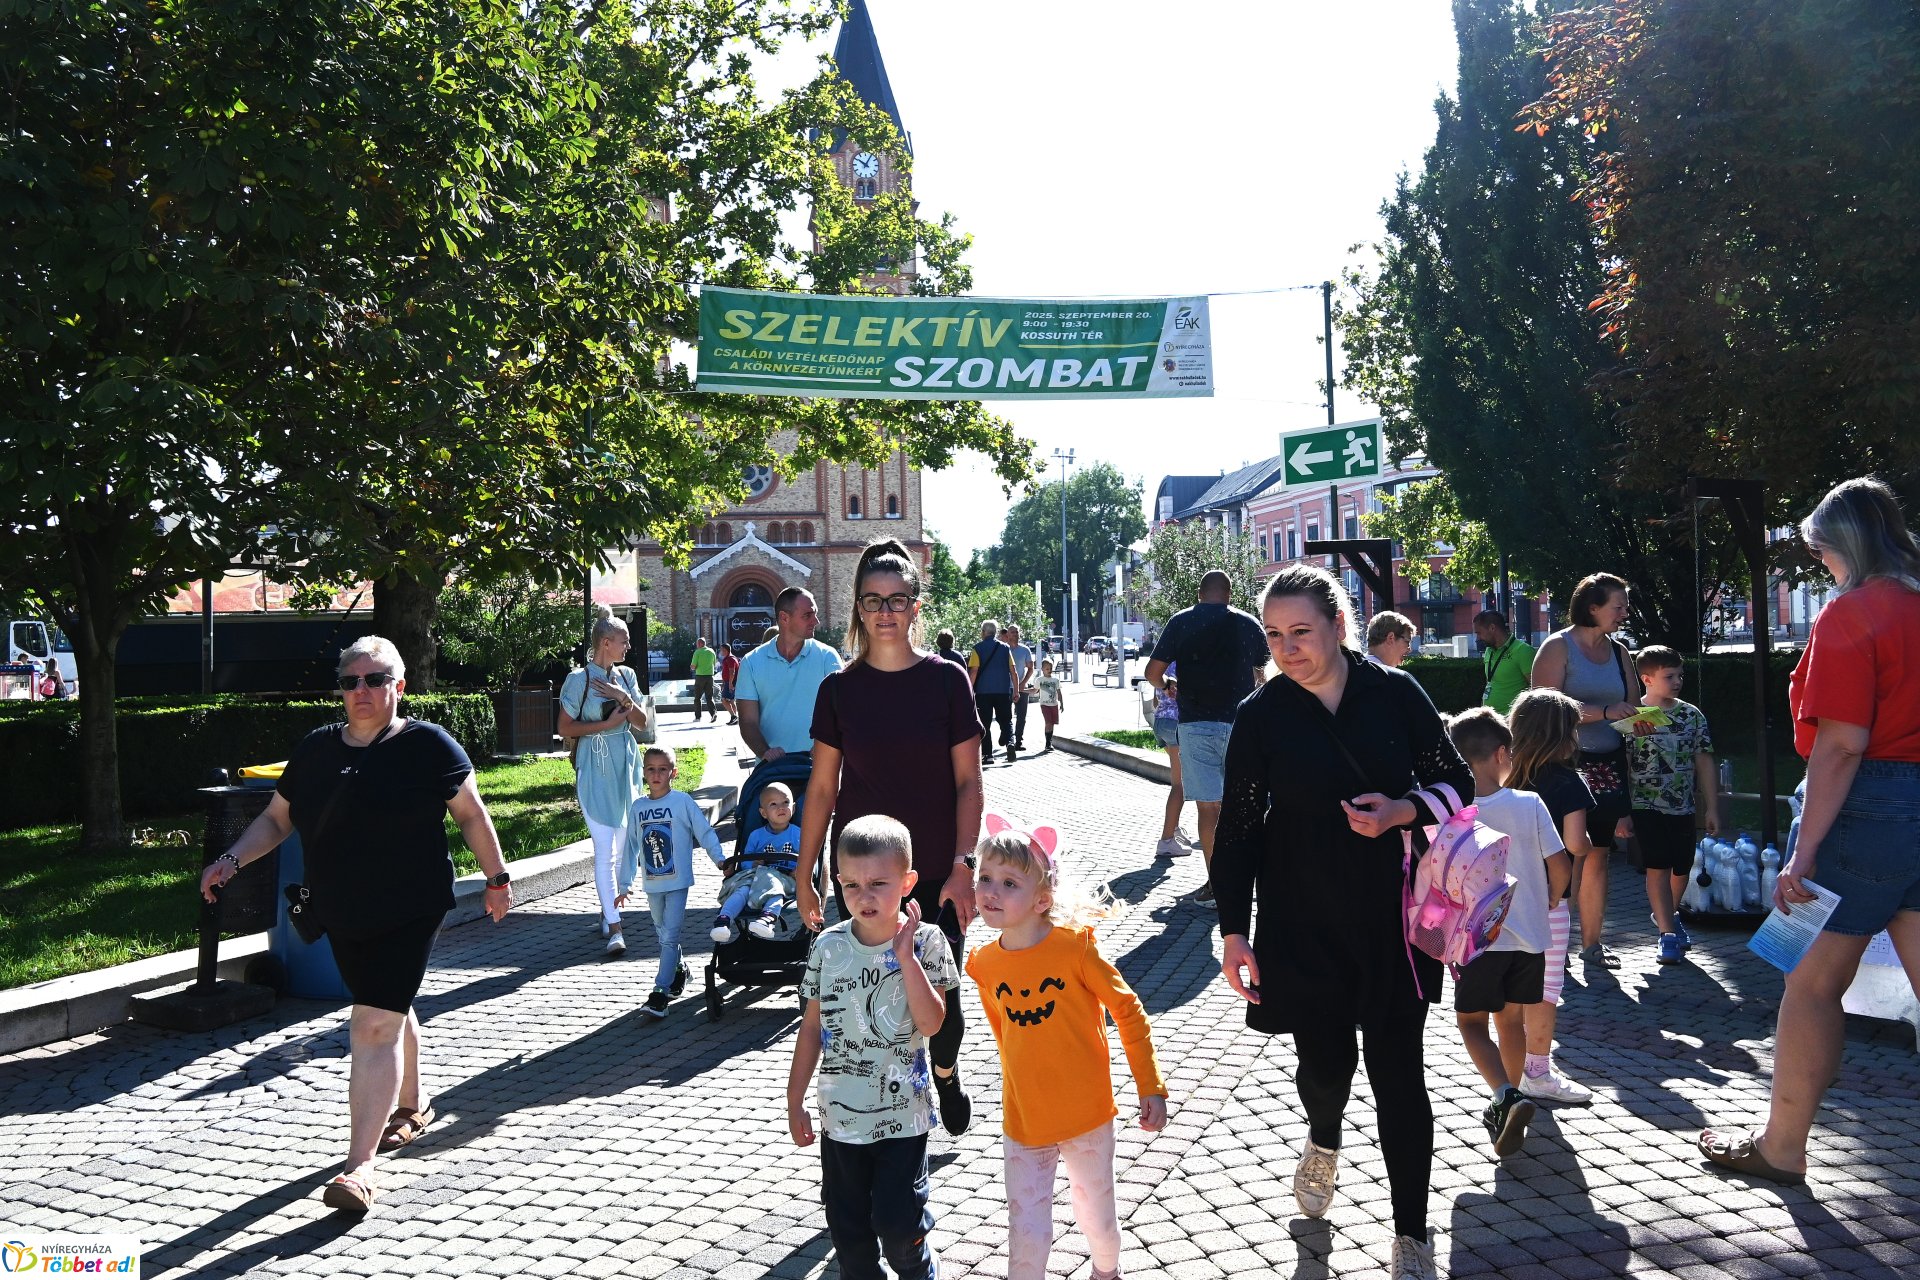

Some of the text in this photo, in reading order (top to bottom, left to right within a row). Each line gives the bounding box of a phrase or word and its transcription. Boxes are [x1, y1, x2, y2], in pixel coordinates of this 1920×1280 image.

[1025, 311, 1152, 320] 2025. SZEPTEMBER 20.
[719, 309, 1013, 348] SZELEKTÍV
[1021, 330, 1103, 340] KOSSUTH TÉR
[713, 347, 886, 365] CSALÁDI VETÉLKEDŐNAP
[729, 361, 883, 376] A KÖRNYEZETÜNKÉRT
[889, 356, 1148, 389] SZOMBAT
[639, 807, 673, 820] NASA
[847, 980, 857, 991] DO
[889, 1123, 903, 1134] DO
